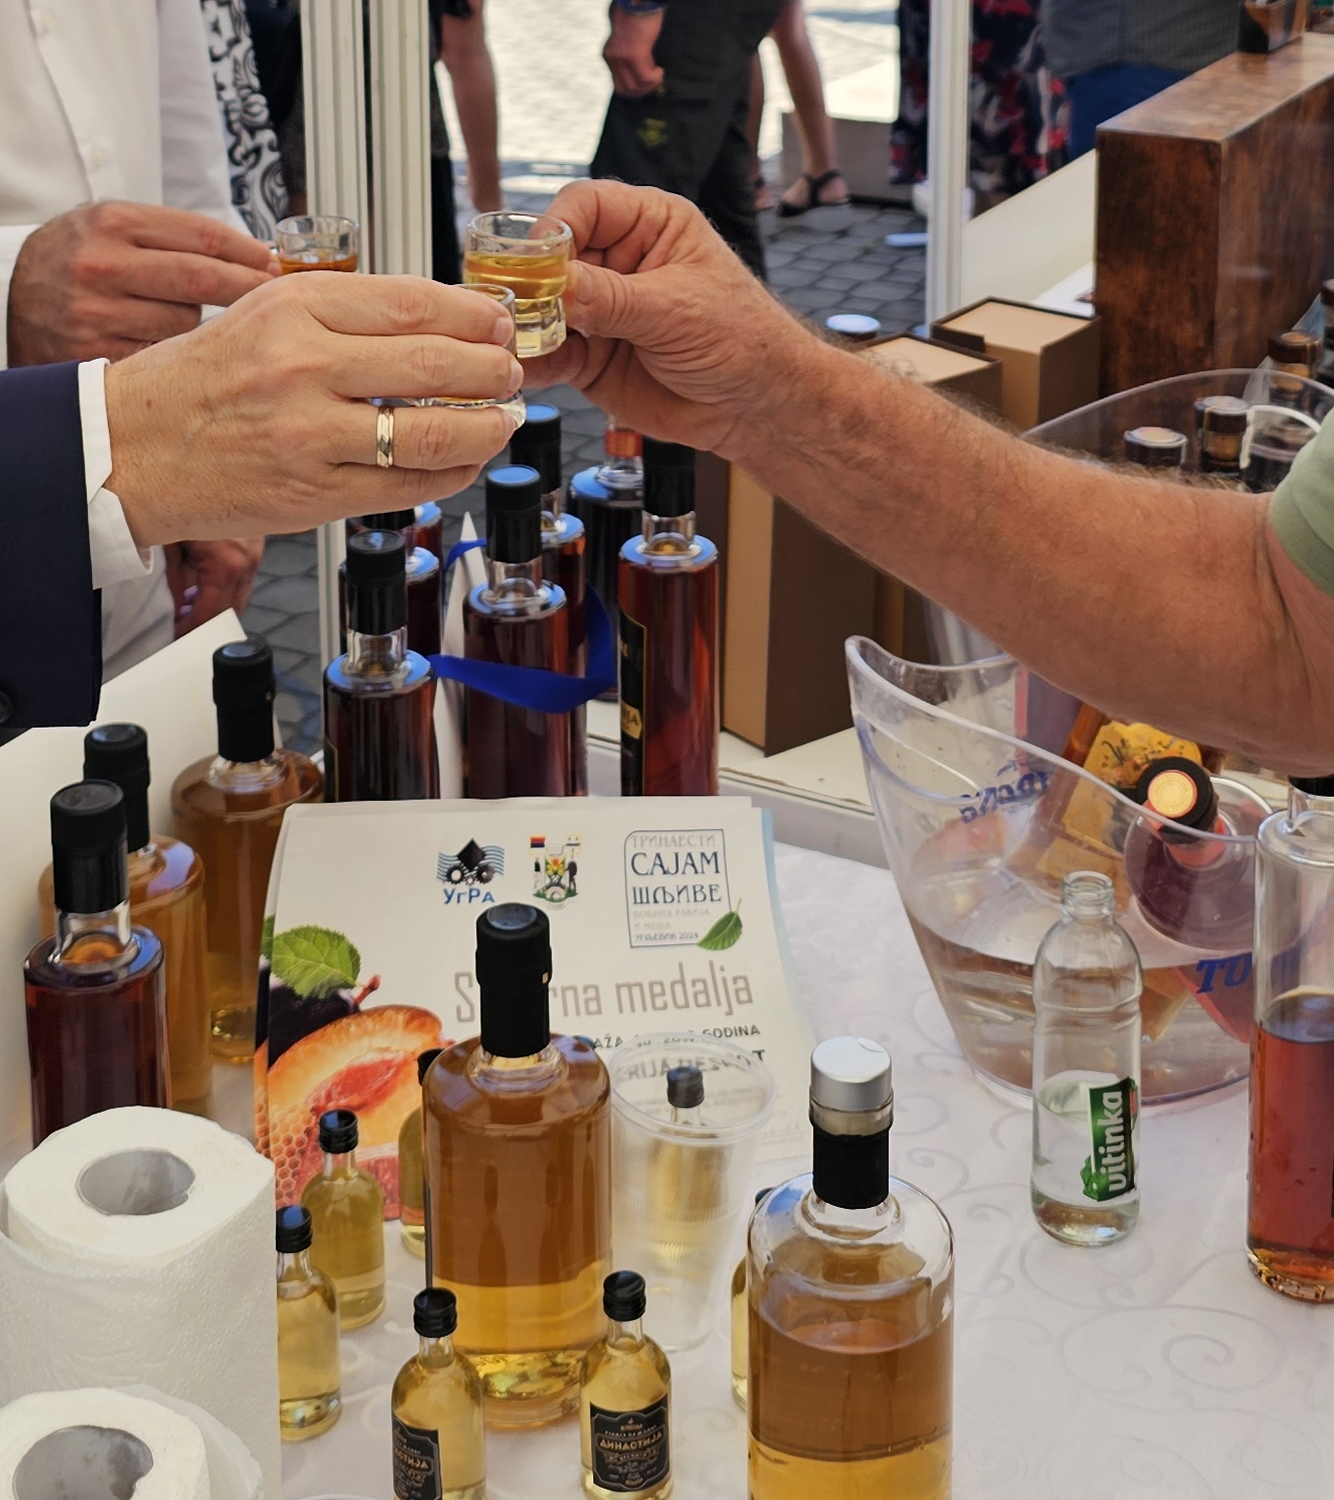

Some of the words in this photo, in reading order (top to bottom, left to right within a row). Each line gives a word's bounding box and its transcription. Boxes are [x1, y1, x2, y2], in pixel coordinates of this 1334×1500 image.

[630, 834, 716, 848] ТРИНАЕСТИ
[630, 851, 720, 876] САЈАМ
[632, 883, 722, 905] ШЉИВЕ
[679, 930, 699, 941] 2024
[616, 959, 754, 1016] medalja
[702, 1024, 761, 1043] GODINA
[599, 1430, 663, 1451] ДИНАСТИЈА
